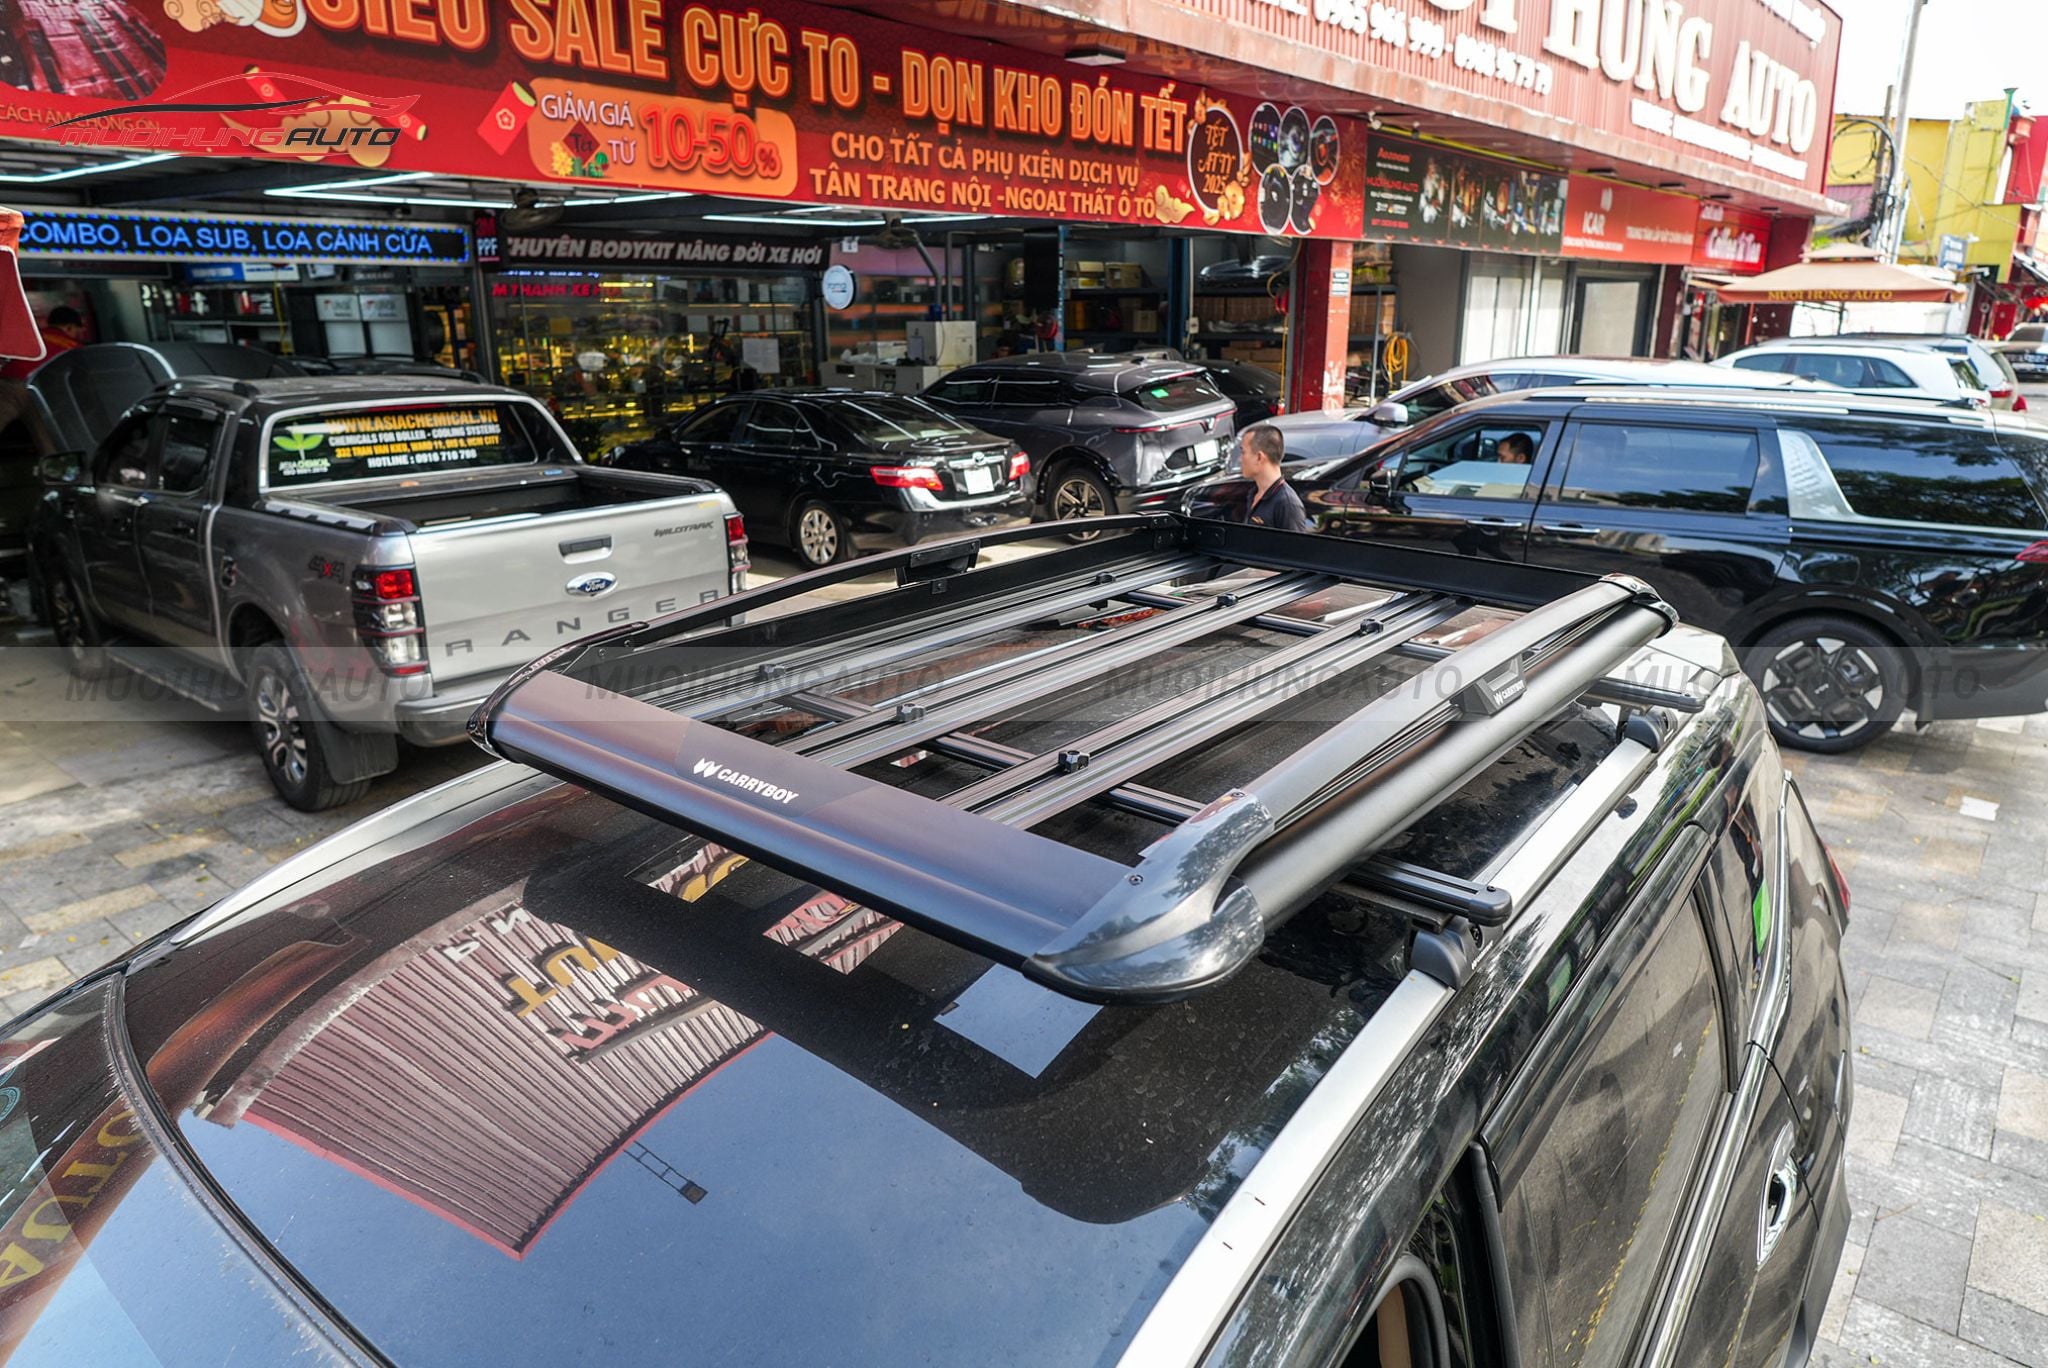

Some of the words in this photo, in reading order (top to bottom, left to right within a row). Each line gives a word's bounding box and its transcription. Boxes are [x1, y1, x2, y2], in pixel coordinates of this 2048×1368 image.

[510, 0, 668, 79] SALE
[683, 7, 789, 107] CỰC
[802, 30, 859, 107] TO
[902, 50, 983, 135] DỌN
[994, 67, 1062, 136] KHO
[1070, 75, 1133, 146] ĐÓN
[1141, 81, 1187, 153] TẾT
[541, 91, 597, 123] GIẢM
[600, 101, 634, 128] GIÁ
[1720, 40, 1817, 153] AUTO
[608, 137, 637, 164] TỪ
[831, 131, 884, 162] CHO
[889, 132, 933, 166] TẤT
[938, 138, 967, 170] CẢ
[972, 148, 1013, 180] PHỤ
[1019, 149, 1064, 184] KIỆN
[1069, 160, 1112, 187] DỊCH
[1116, 165, 1139, 192] VỤ
[810, 161, 861, 198] TÂN
[867, 173, 946, 204] TRANG
[952, 175, 992, 212] NỘI
[1071, 187, 1115, 215] THẤT
[1118, 189, 1131, 217] Ô
[1134, 192, 1156, 218] TÔ
[135, 224, 193, 247] LOA
[196, 227, 257, 251] SUB,
[262, 230, 312, 250] LOA
[316, 229, 380, 252] CÁNH
[476, 238, 498, 256] PPF
[507, 234, 585, 258] HUYÊN
[588, 239, 676, 260] BODYKIT
[675, 239, 731, 262] NÂNG
[766, 246, 791, 263] XE
[791, 245, 823, 265] HƠI
[1852, 289, 1893, 300] AUTO
[717, 768, 799, 804] CARRYBOY
